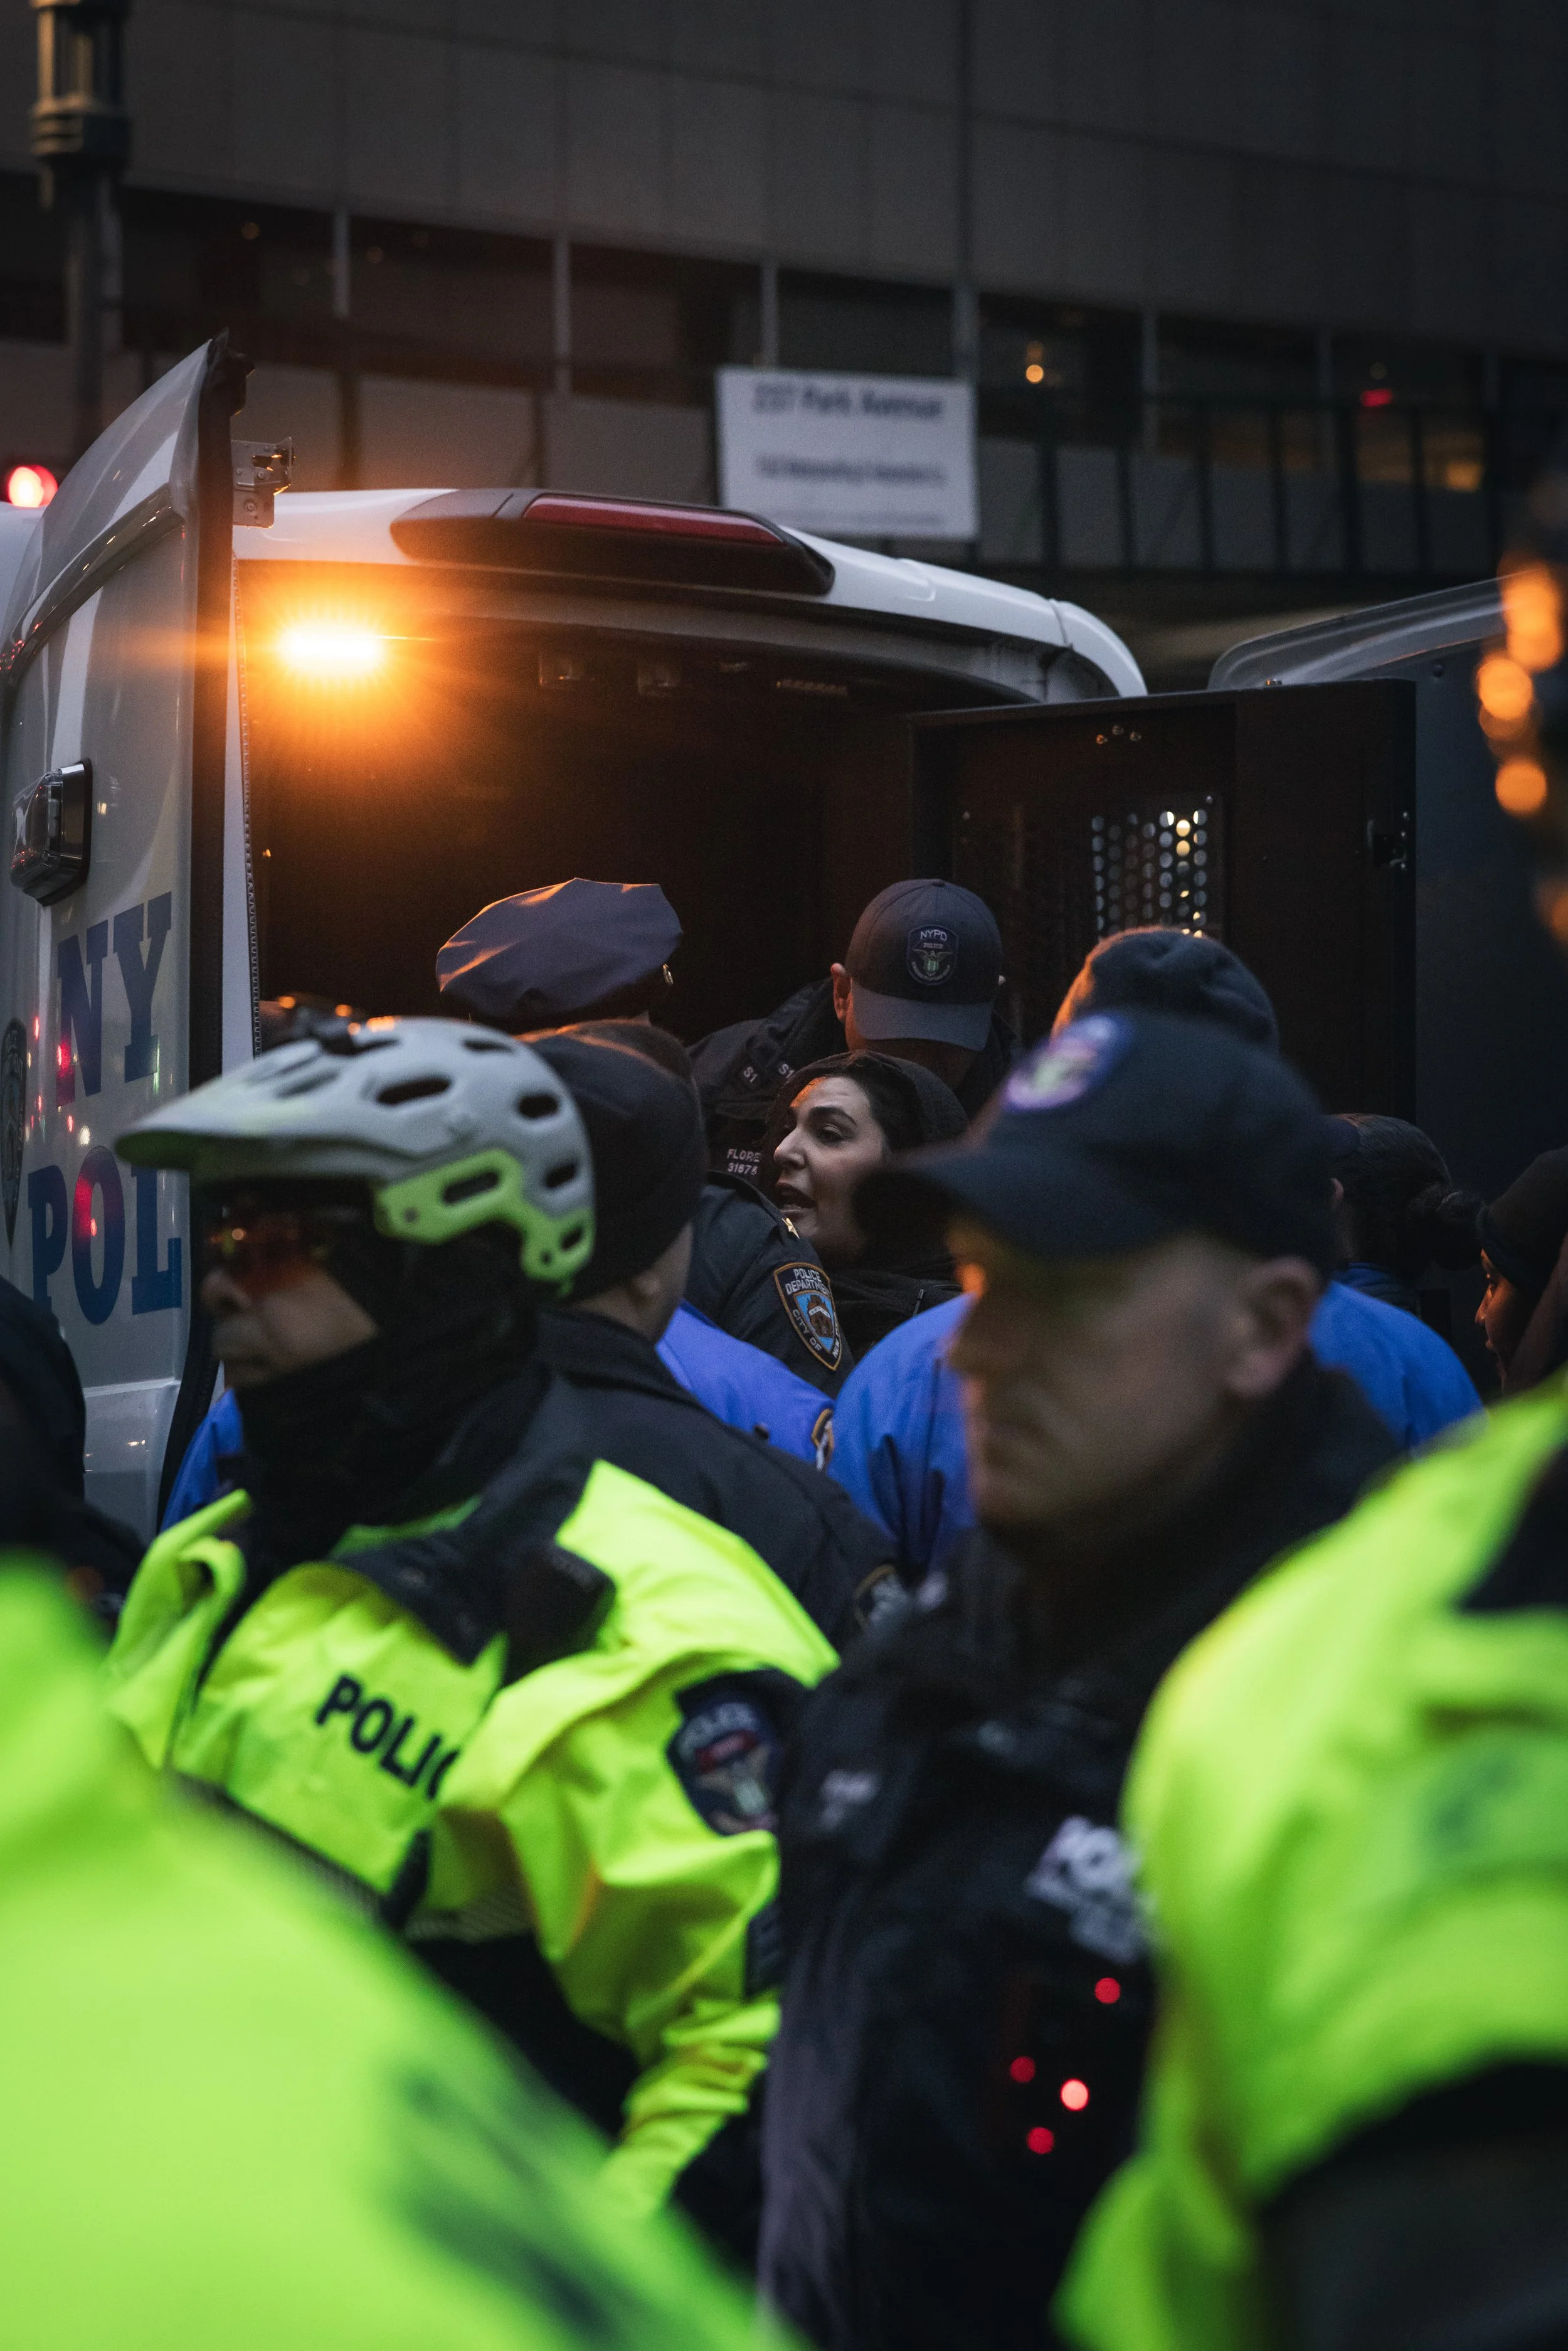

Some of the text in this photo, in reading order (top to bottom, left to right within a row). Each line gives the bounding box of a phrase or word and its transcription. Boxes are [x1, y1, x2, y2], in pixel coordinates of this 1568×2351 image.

[919, 929, 948, 942] NYPD
[56, 892, 172, 1107] NY
[27, 1146, 183, 1325] POL
[785, 1278, 831, 1298] DEPARTME
[793, 1268, 822, 1283] POLICE
[792, 1308, 823, 1352] CITY OF
[315, 1672, 462, 1802] POLIC
